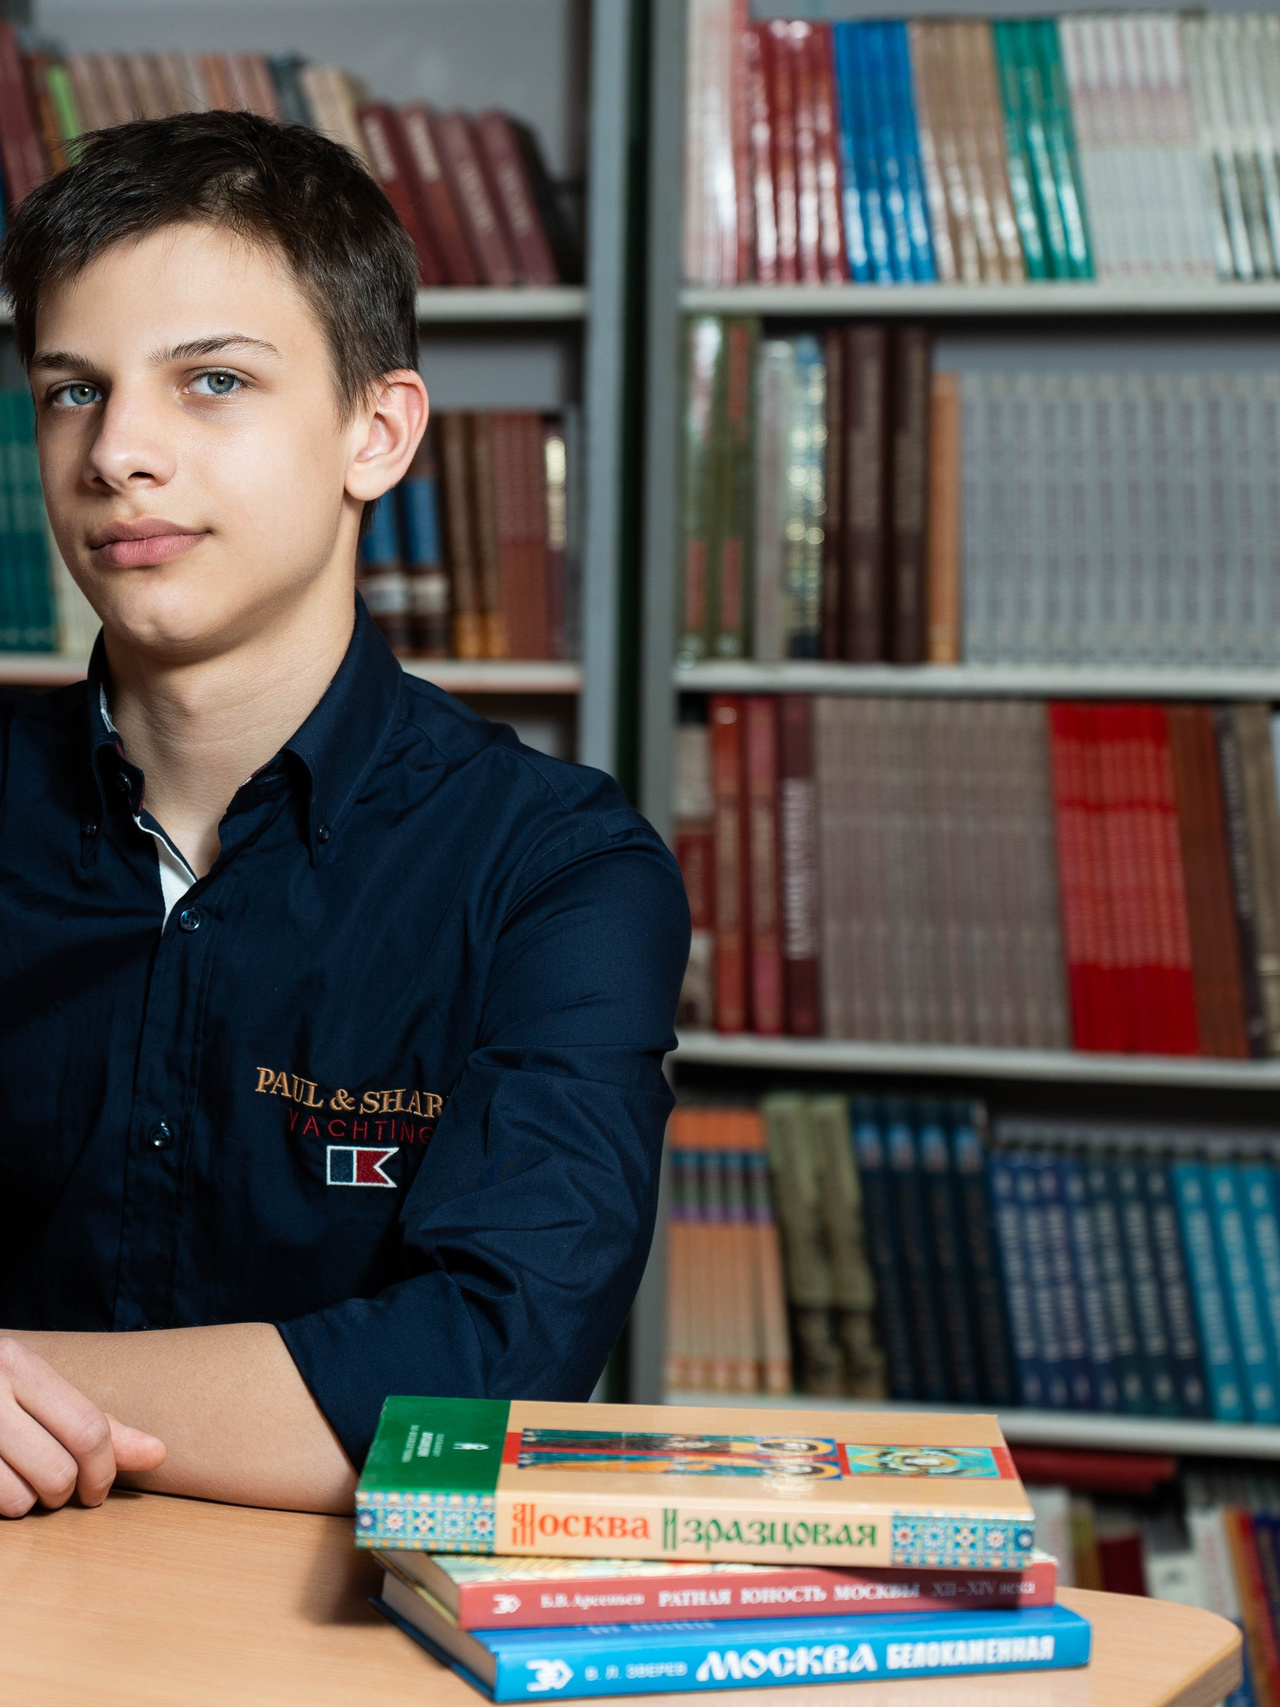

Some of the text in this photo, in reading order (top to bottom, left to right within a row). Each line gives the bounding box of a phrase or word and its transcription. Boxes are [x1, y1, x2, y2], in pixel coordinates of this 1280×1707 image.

[255, 1067, 448, 1119] PAUL & SHAR
[288, 1108, 436, 1145] YACHTING
[662, 1507, 878, 1554] Изразцовая
[658, 1588, 732, 1608] РАТНАЯ
[740, 1585, 828, 1604] ЮНОСТЬ
[833, 1583, 920, 1601] МОСКВЫ
[695, 1643, 878, 1682] МОСКВА
[886, 1634, 1055, 1670] БЕЛОКАМЕННАЯ
